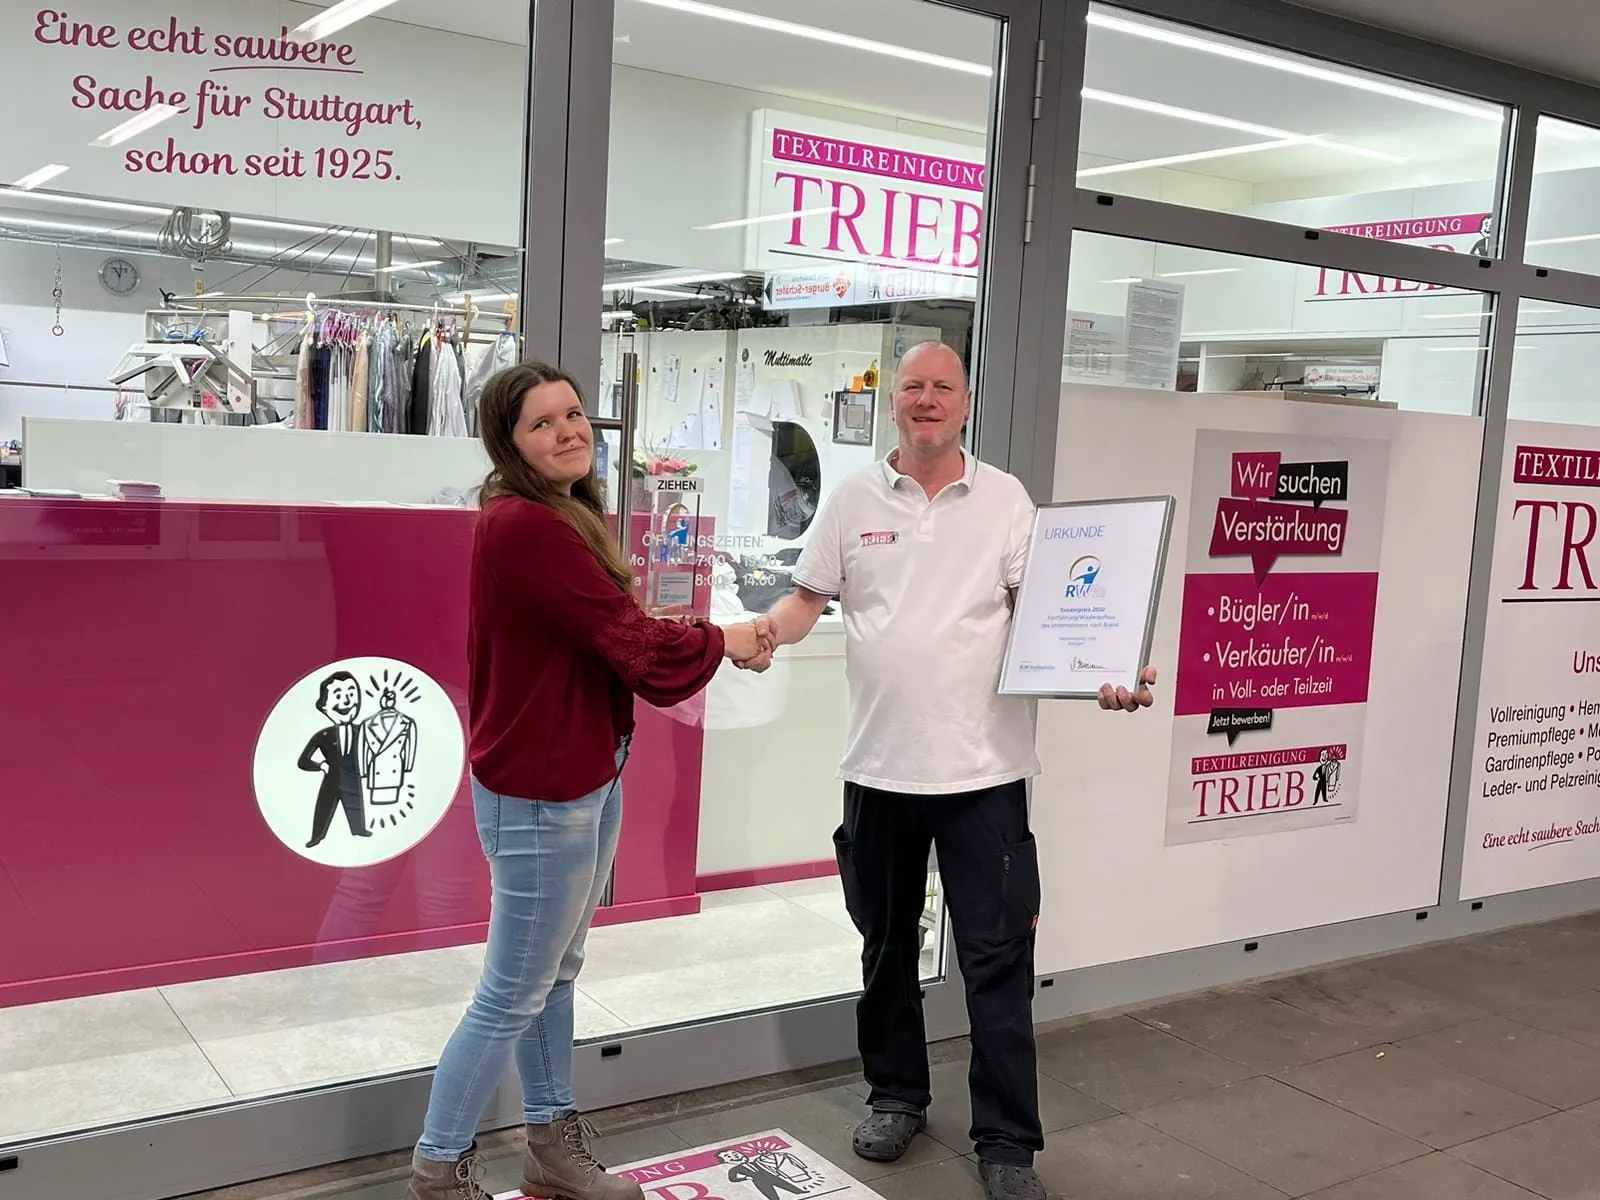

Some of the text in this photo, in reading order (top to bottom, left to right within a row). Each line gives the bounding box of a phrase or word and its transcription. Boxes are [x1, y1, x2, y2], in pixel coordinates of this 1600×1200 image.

[34, 9, 357, 66] Eine echt saubere
[72, 75, 422, 136] Sache für Stuttgart,
[124, 137, 402, 181] schon seit 1925.
[774, 171, 983, 269] TRIEB
[764, 350, 813, 367] Multimatic
[657, 480, 698, 491] ZIEHEN
[1237, 461, 1342, 495] Wir suchen
[1044, 525, 1106, 540] URKUNDE
[1220, 510, 1342, 551] Verstärkung
[1219, 592, 1310, 631] Bügler/in
[1216, 635, 1336, 668] Verkäufer/in
[1212, 675, 1333, 700] in Voll- oder Teilzeit
[1212, 712, 1271, 728] Jetzt bewerben!
[1490, 704, 1566, 723] Vollreinigung
[1487, 727, 1576, 749] Premiumpflege
[1194, 750, 1307, 772] TEXTILREINIGUNG
[1485, 750, 1575, 773] Gardinenpflege
[1192, 771, 1305, 818] TRIEB
[1482, 781, 1522, 798] Leder-
[1525, 775, 1548, 793] und
[1482, 816, 1600, 849] Eine echt saubere Sach
